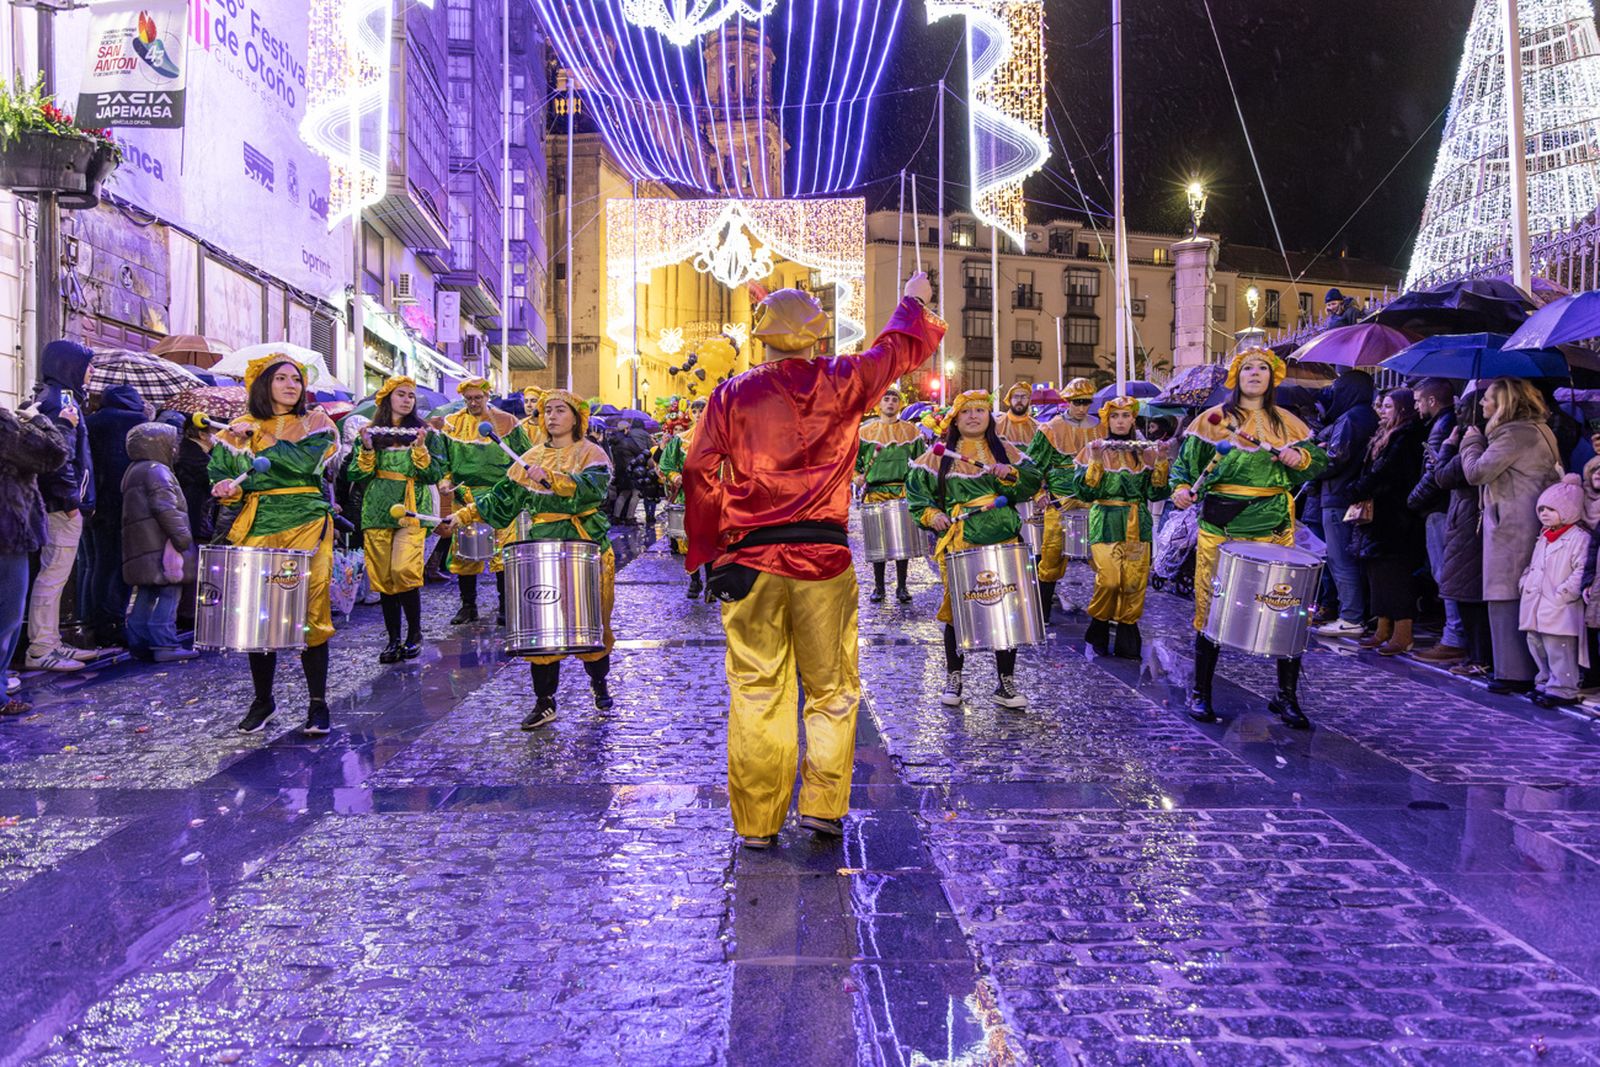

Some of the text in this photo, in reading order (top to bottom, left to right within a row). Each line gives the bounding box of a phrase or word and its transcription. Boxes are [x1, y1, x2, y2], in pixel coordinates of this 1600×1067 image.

[97, 45, 122, 58] SAN
[215, 15, 295, 108] de Otoño
[97, 93, 173, 106] DACIA
[96, 106, 173, 119] JAPEMASA
